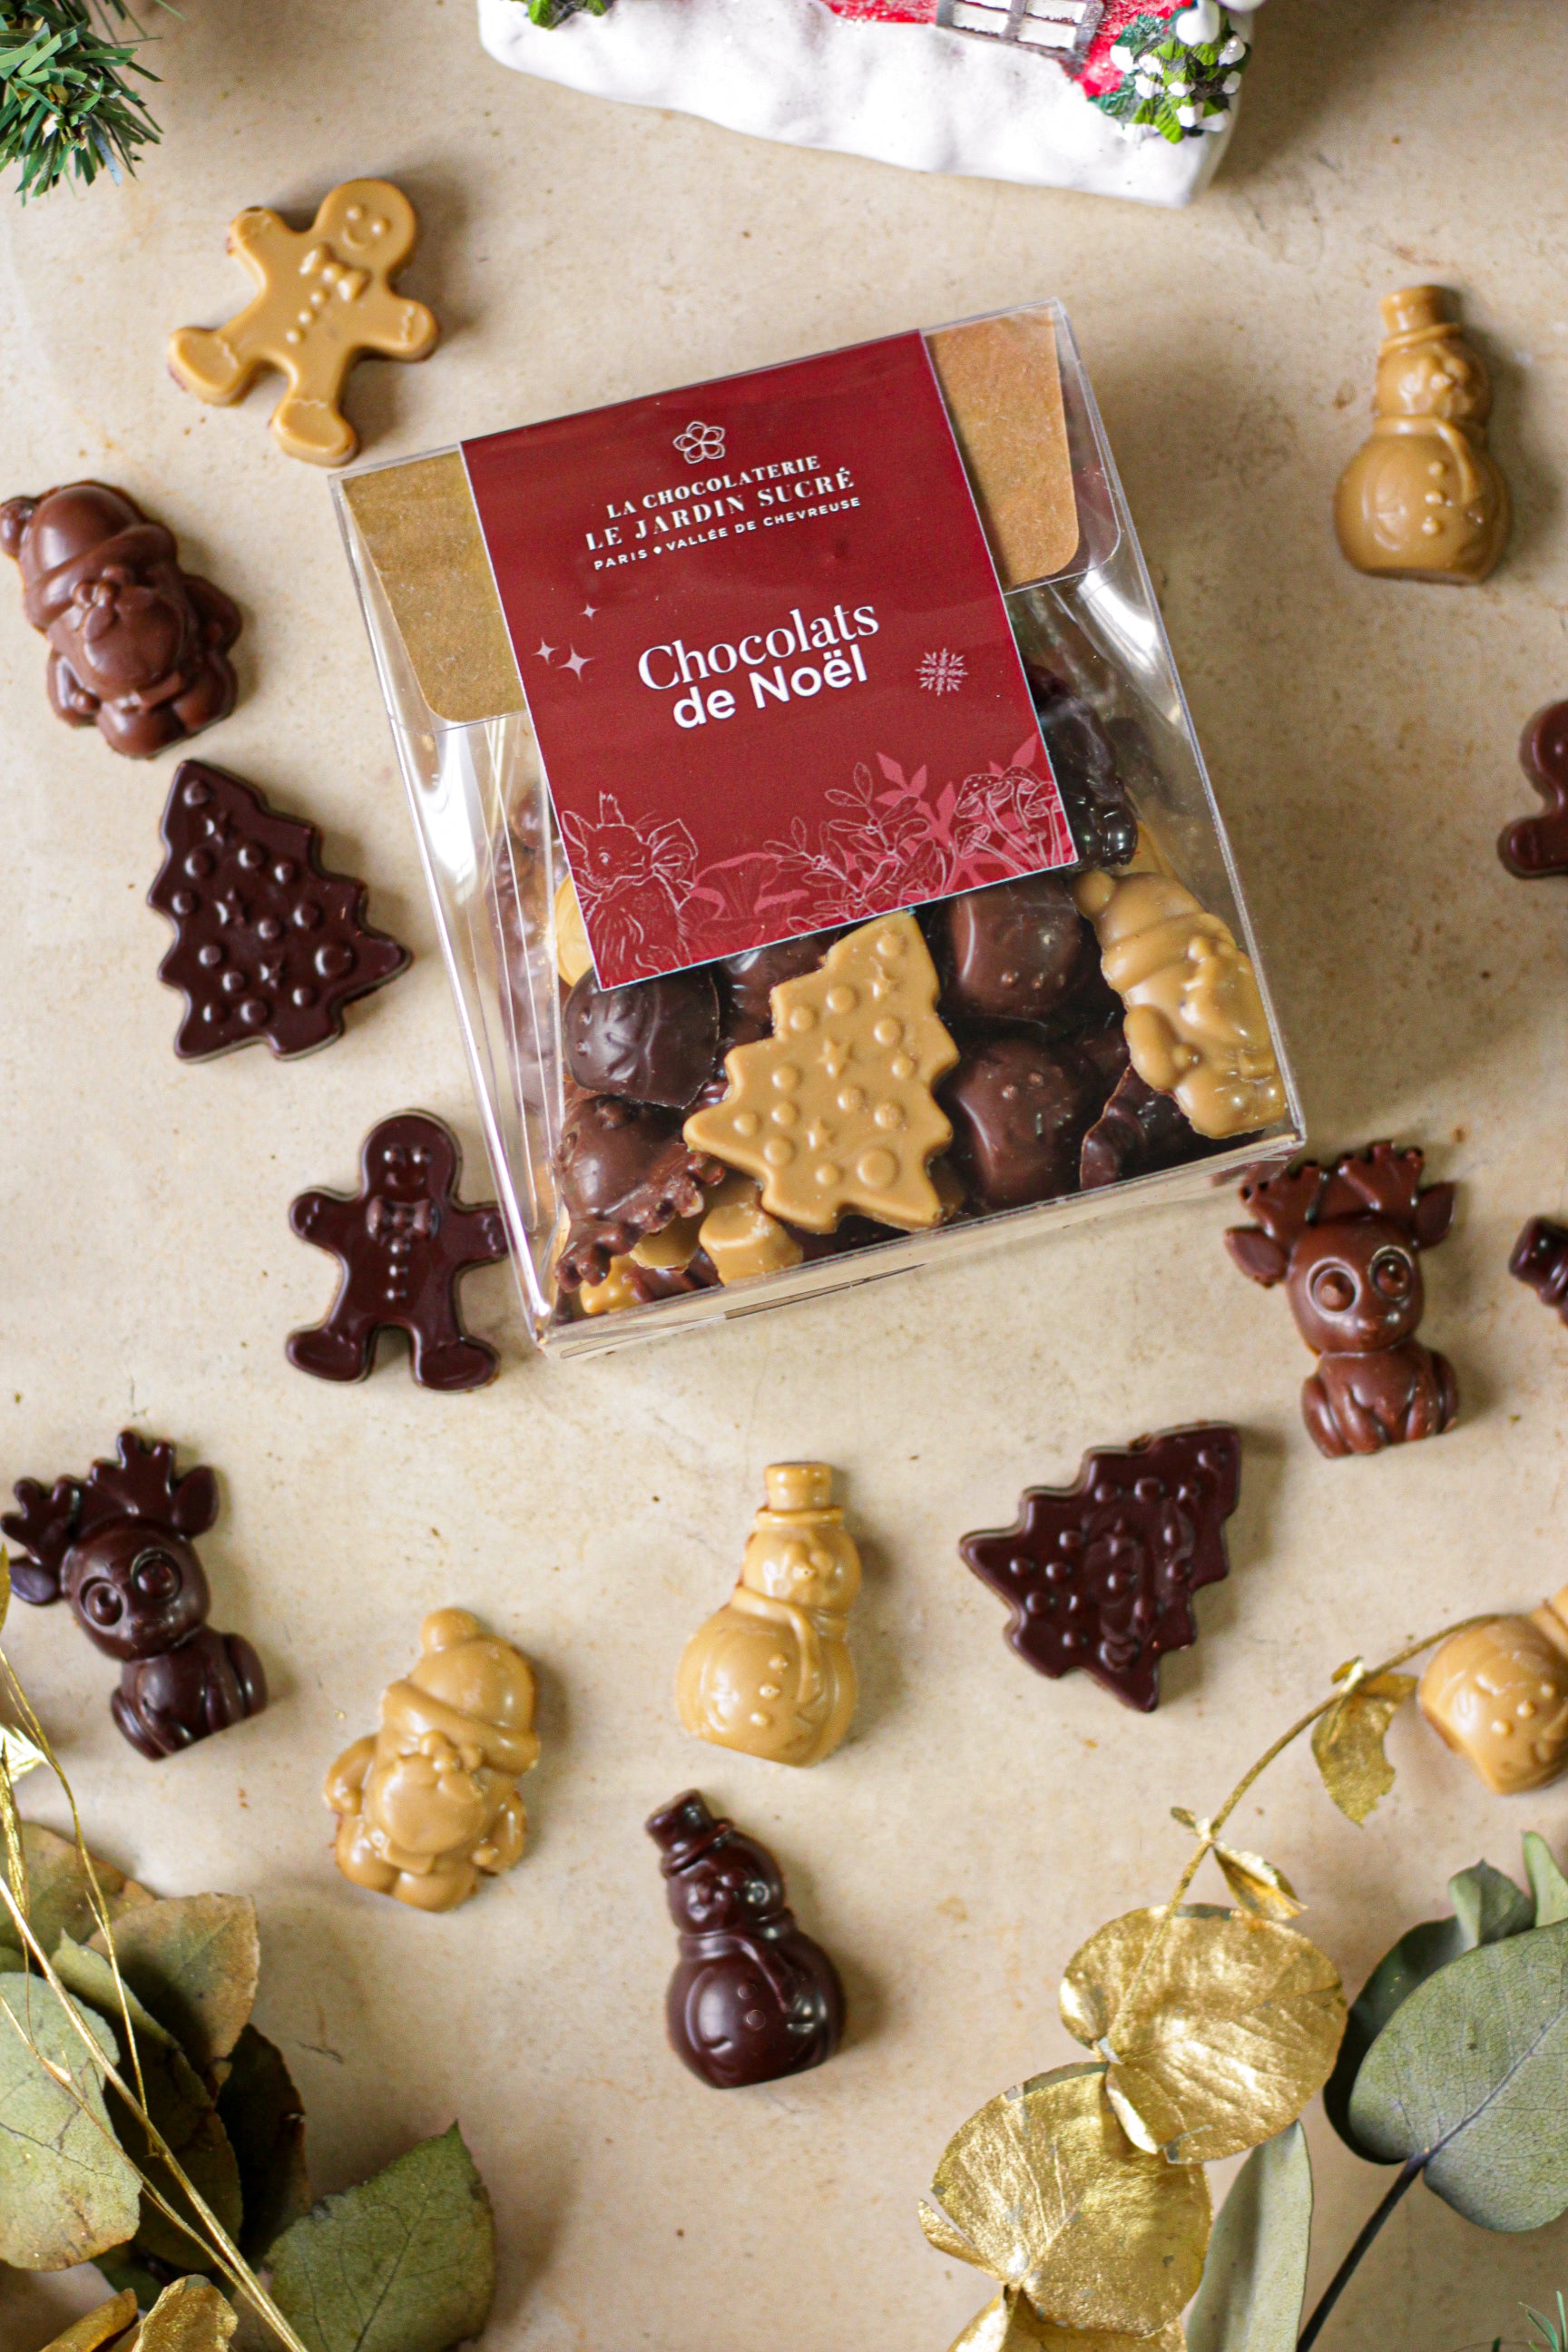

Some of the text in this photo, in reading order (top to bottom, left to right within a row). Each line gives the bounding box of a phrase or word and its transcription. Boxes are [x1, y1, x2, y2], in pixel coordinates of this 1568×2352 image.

[585, 466, 855, 550] LE JARDIN SUCRÉ
[606, 456, 821, 518] LA CHOCOLATERIE
[594, 497, 861, 570] PARIS VALLÉE DE CHEVREUSE
[638, 605, 879, 690] Chocolats
[673, 644, 867, 729] de Noël
